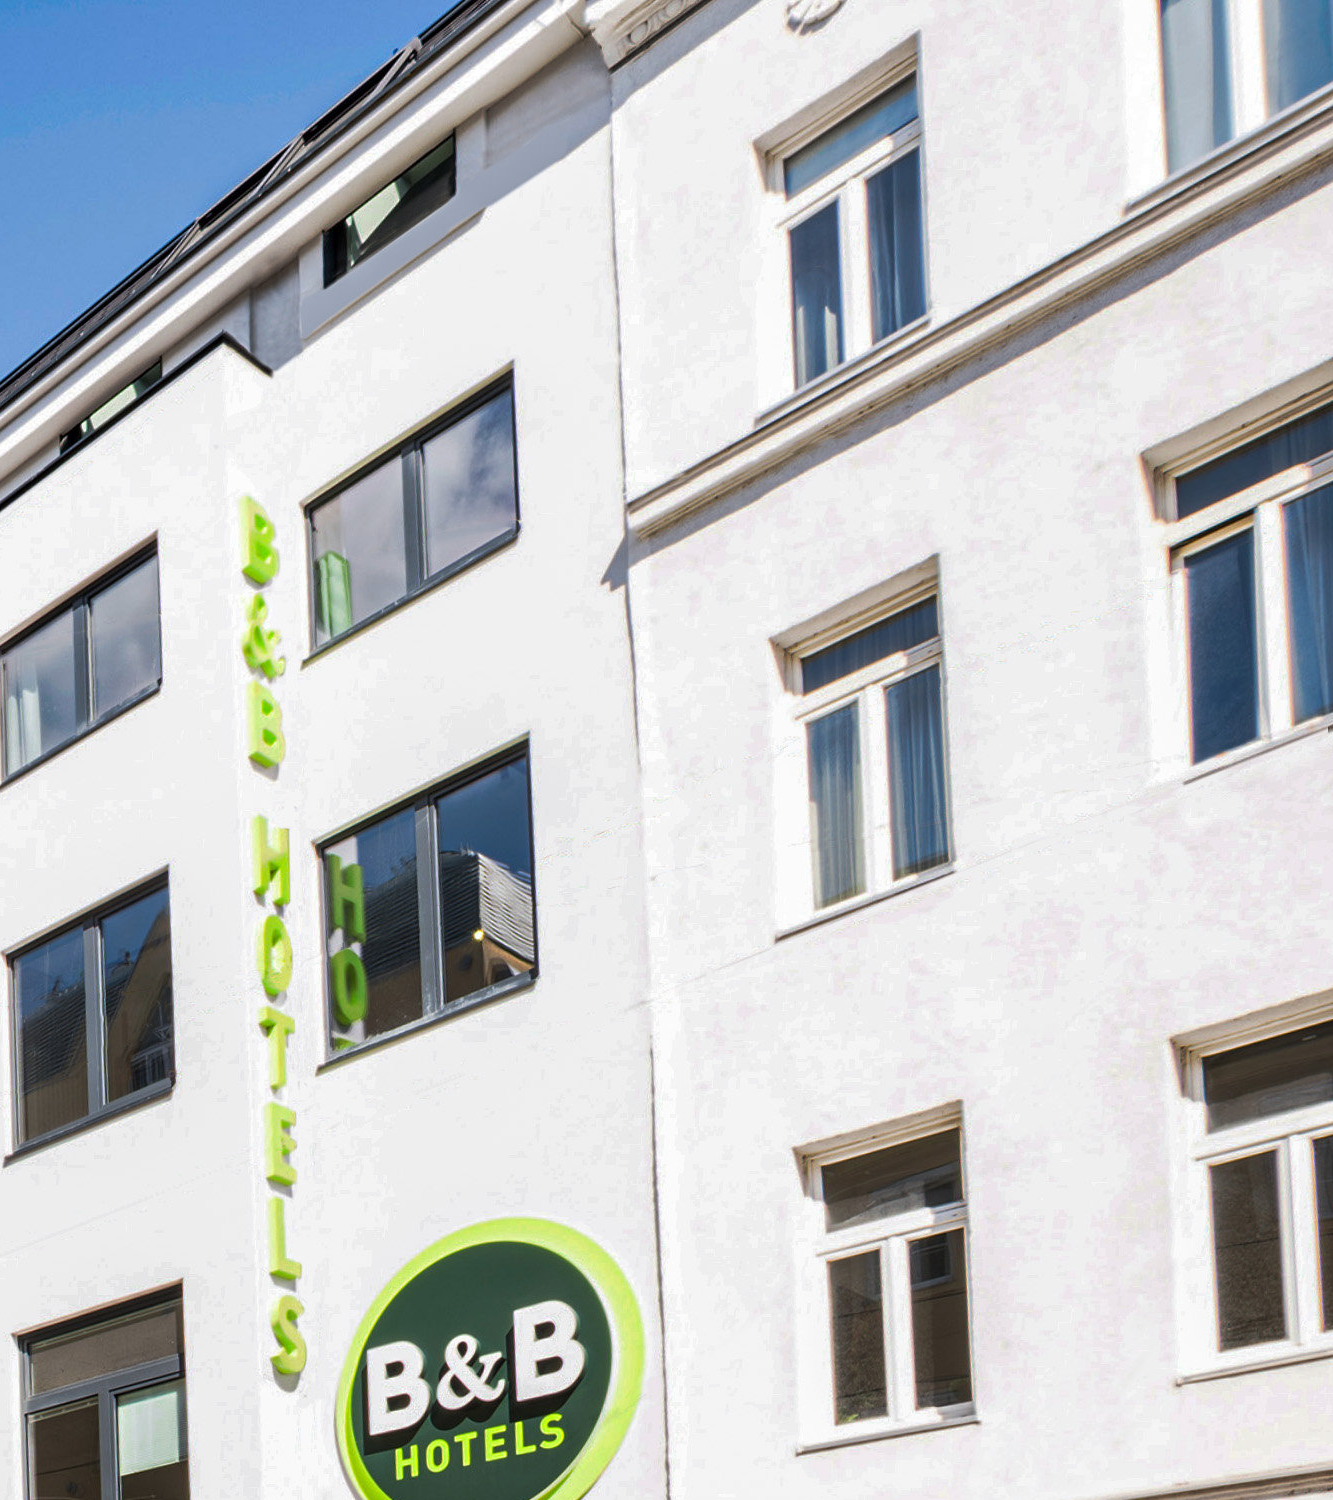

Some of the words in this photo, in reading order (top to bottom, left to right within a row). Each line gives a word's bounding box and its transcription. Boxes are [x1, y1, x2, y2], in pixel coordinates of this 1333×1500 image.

[239, 496, 286, 768] B&B
[251, 815, 307, 1375] HOTELS
[364, 1299, 587, 1440] B&B
[394, 1413, 566, 1481] HOTELS
